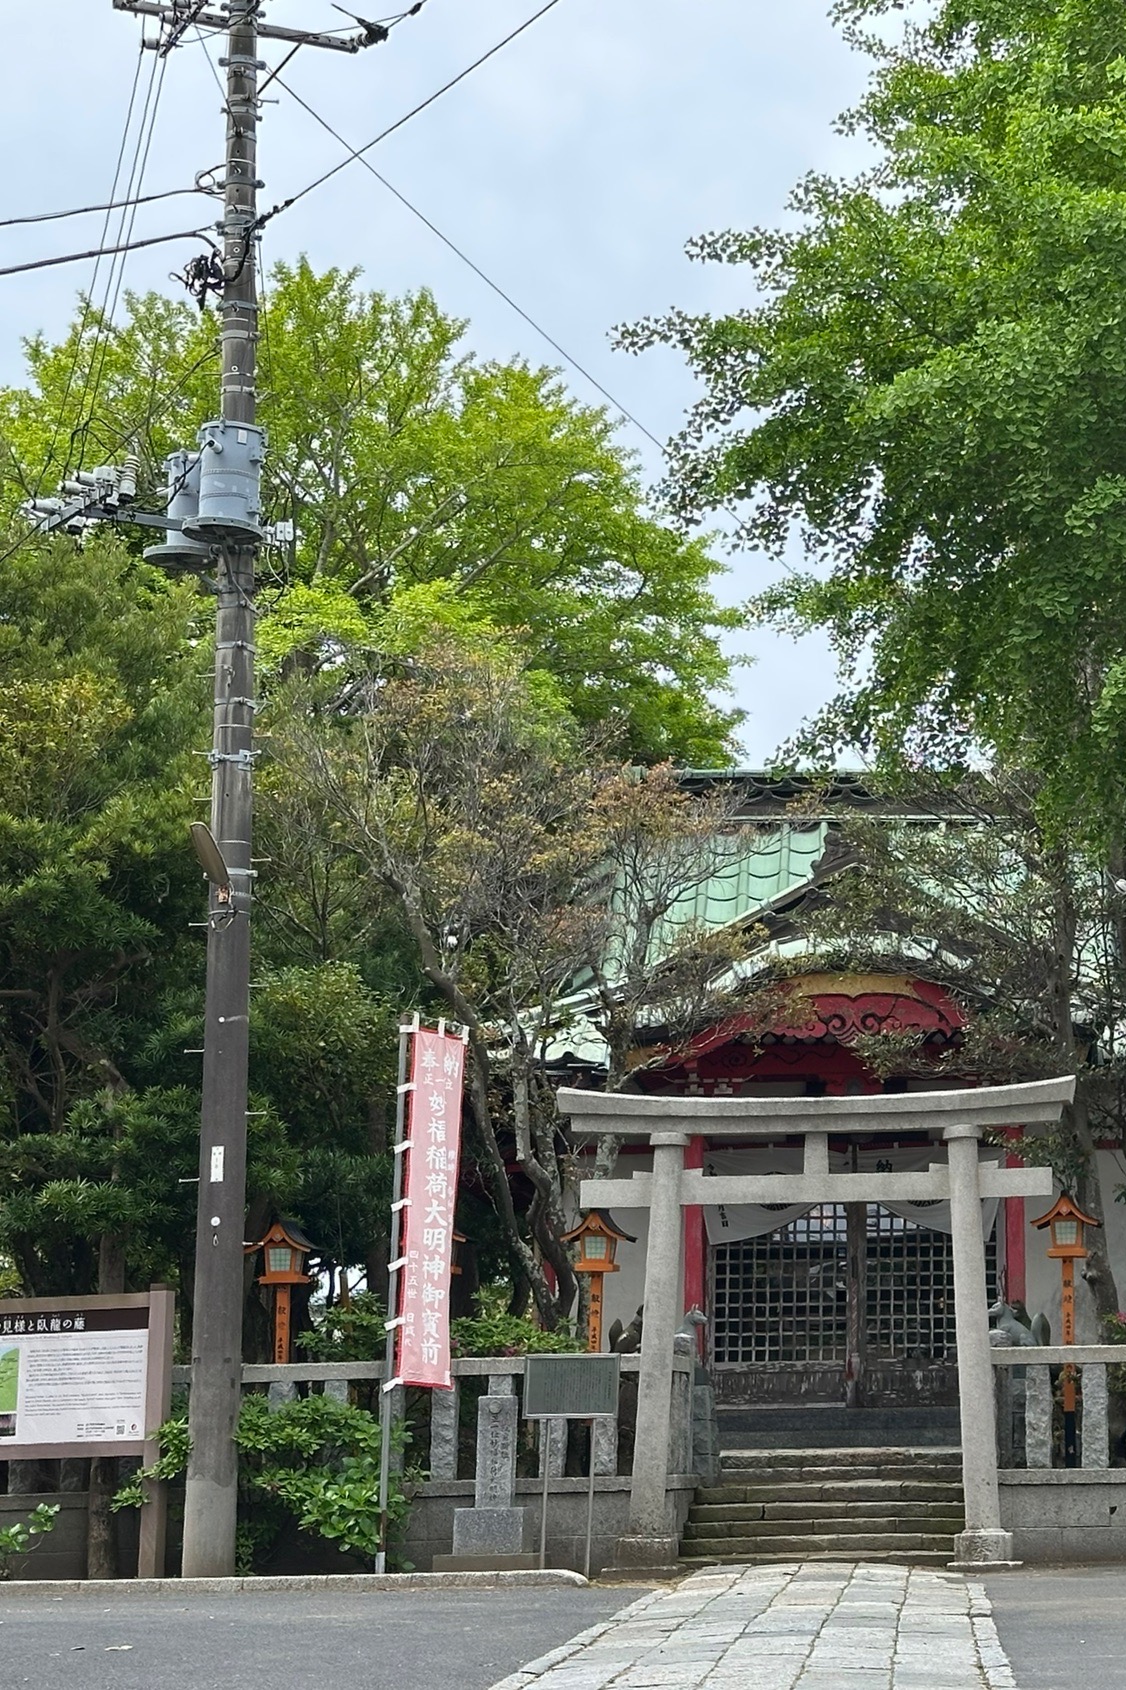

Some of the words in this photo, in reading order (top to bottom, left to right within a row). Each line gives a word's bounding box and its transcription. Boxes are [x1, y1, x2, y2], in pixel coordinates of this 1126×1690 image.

[420, 1048, 460, 1078] 奉納
[407, 1250, 420, 1299] 四十五世
[0, 1317, 85, 1333] 見様と臥龍の藤
